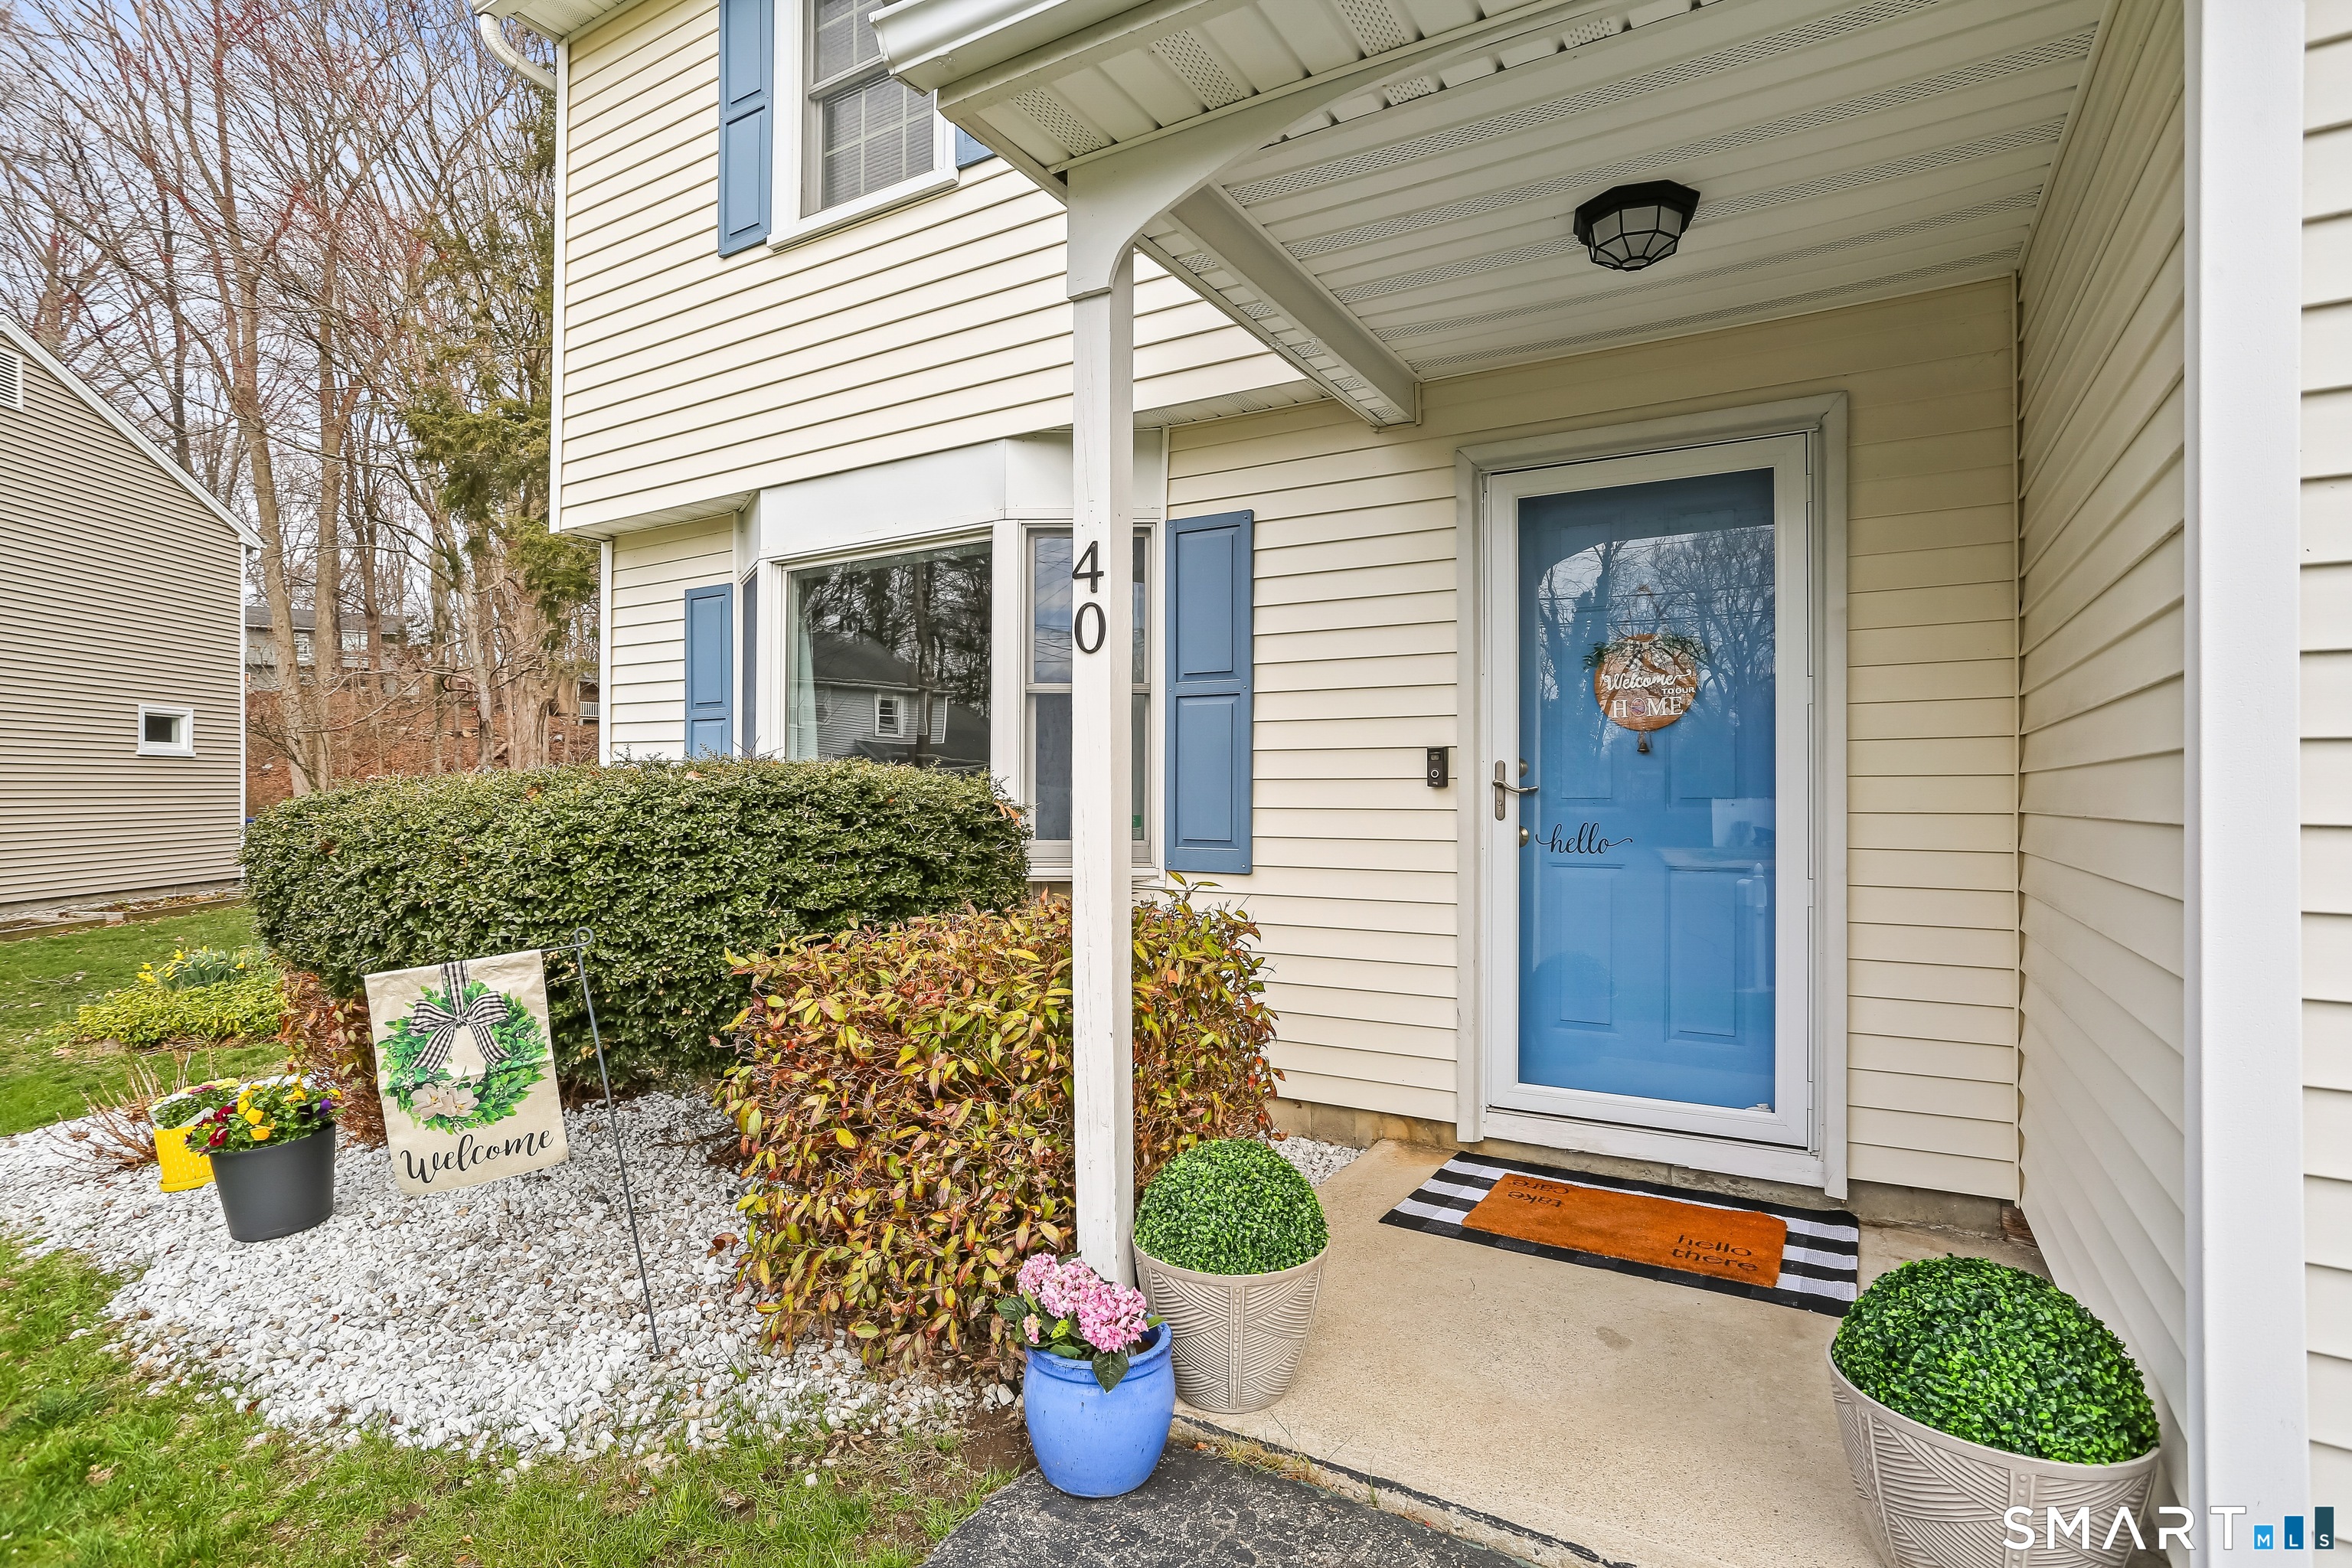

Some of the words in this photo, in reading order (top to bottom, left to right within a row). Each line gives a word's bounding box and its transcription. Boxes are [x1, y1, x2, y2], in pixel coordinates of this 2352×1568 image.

[1072, 541, 1106, 654] 40
[1601, 669, 1692, 691] Welcome
[1535, 822, 1633, 854] hello
[400, 1129, 554, 1184] Welcome
[1512, 1179, 1570, 1194] care
[1508, 1191, 1563, 1207] take
[1677, 1234, 1752, 1256] hello
[1671, 1248, 1758, 1272] there
